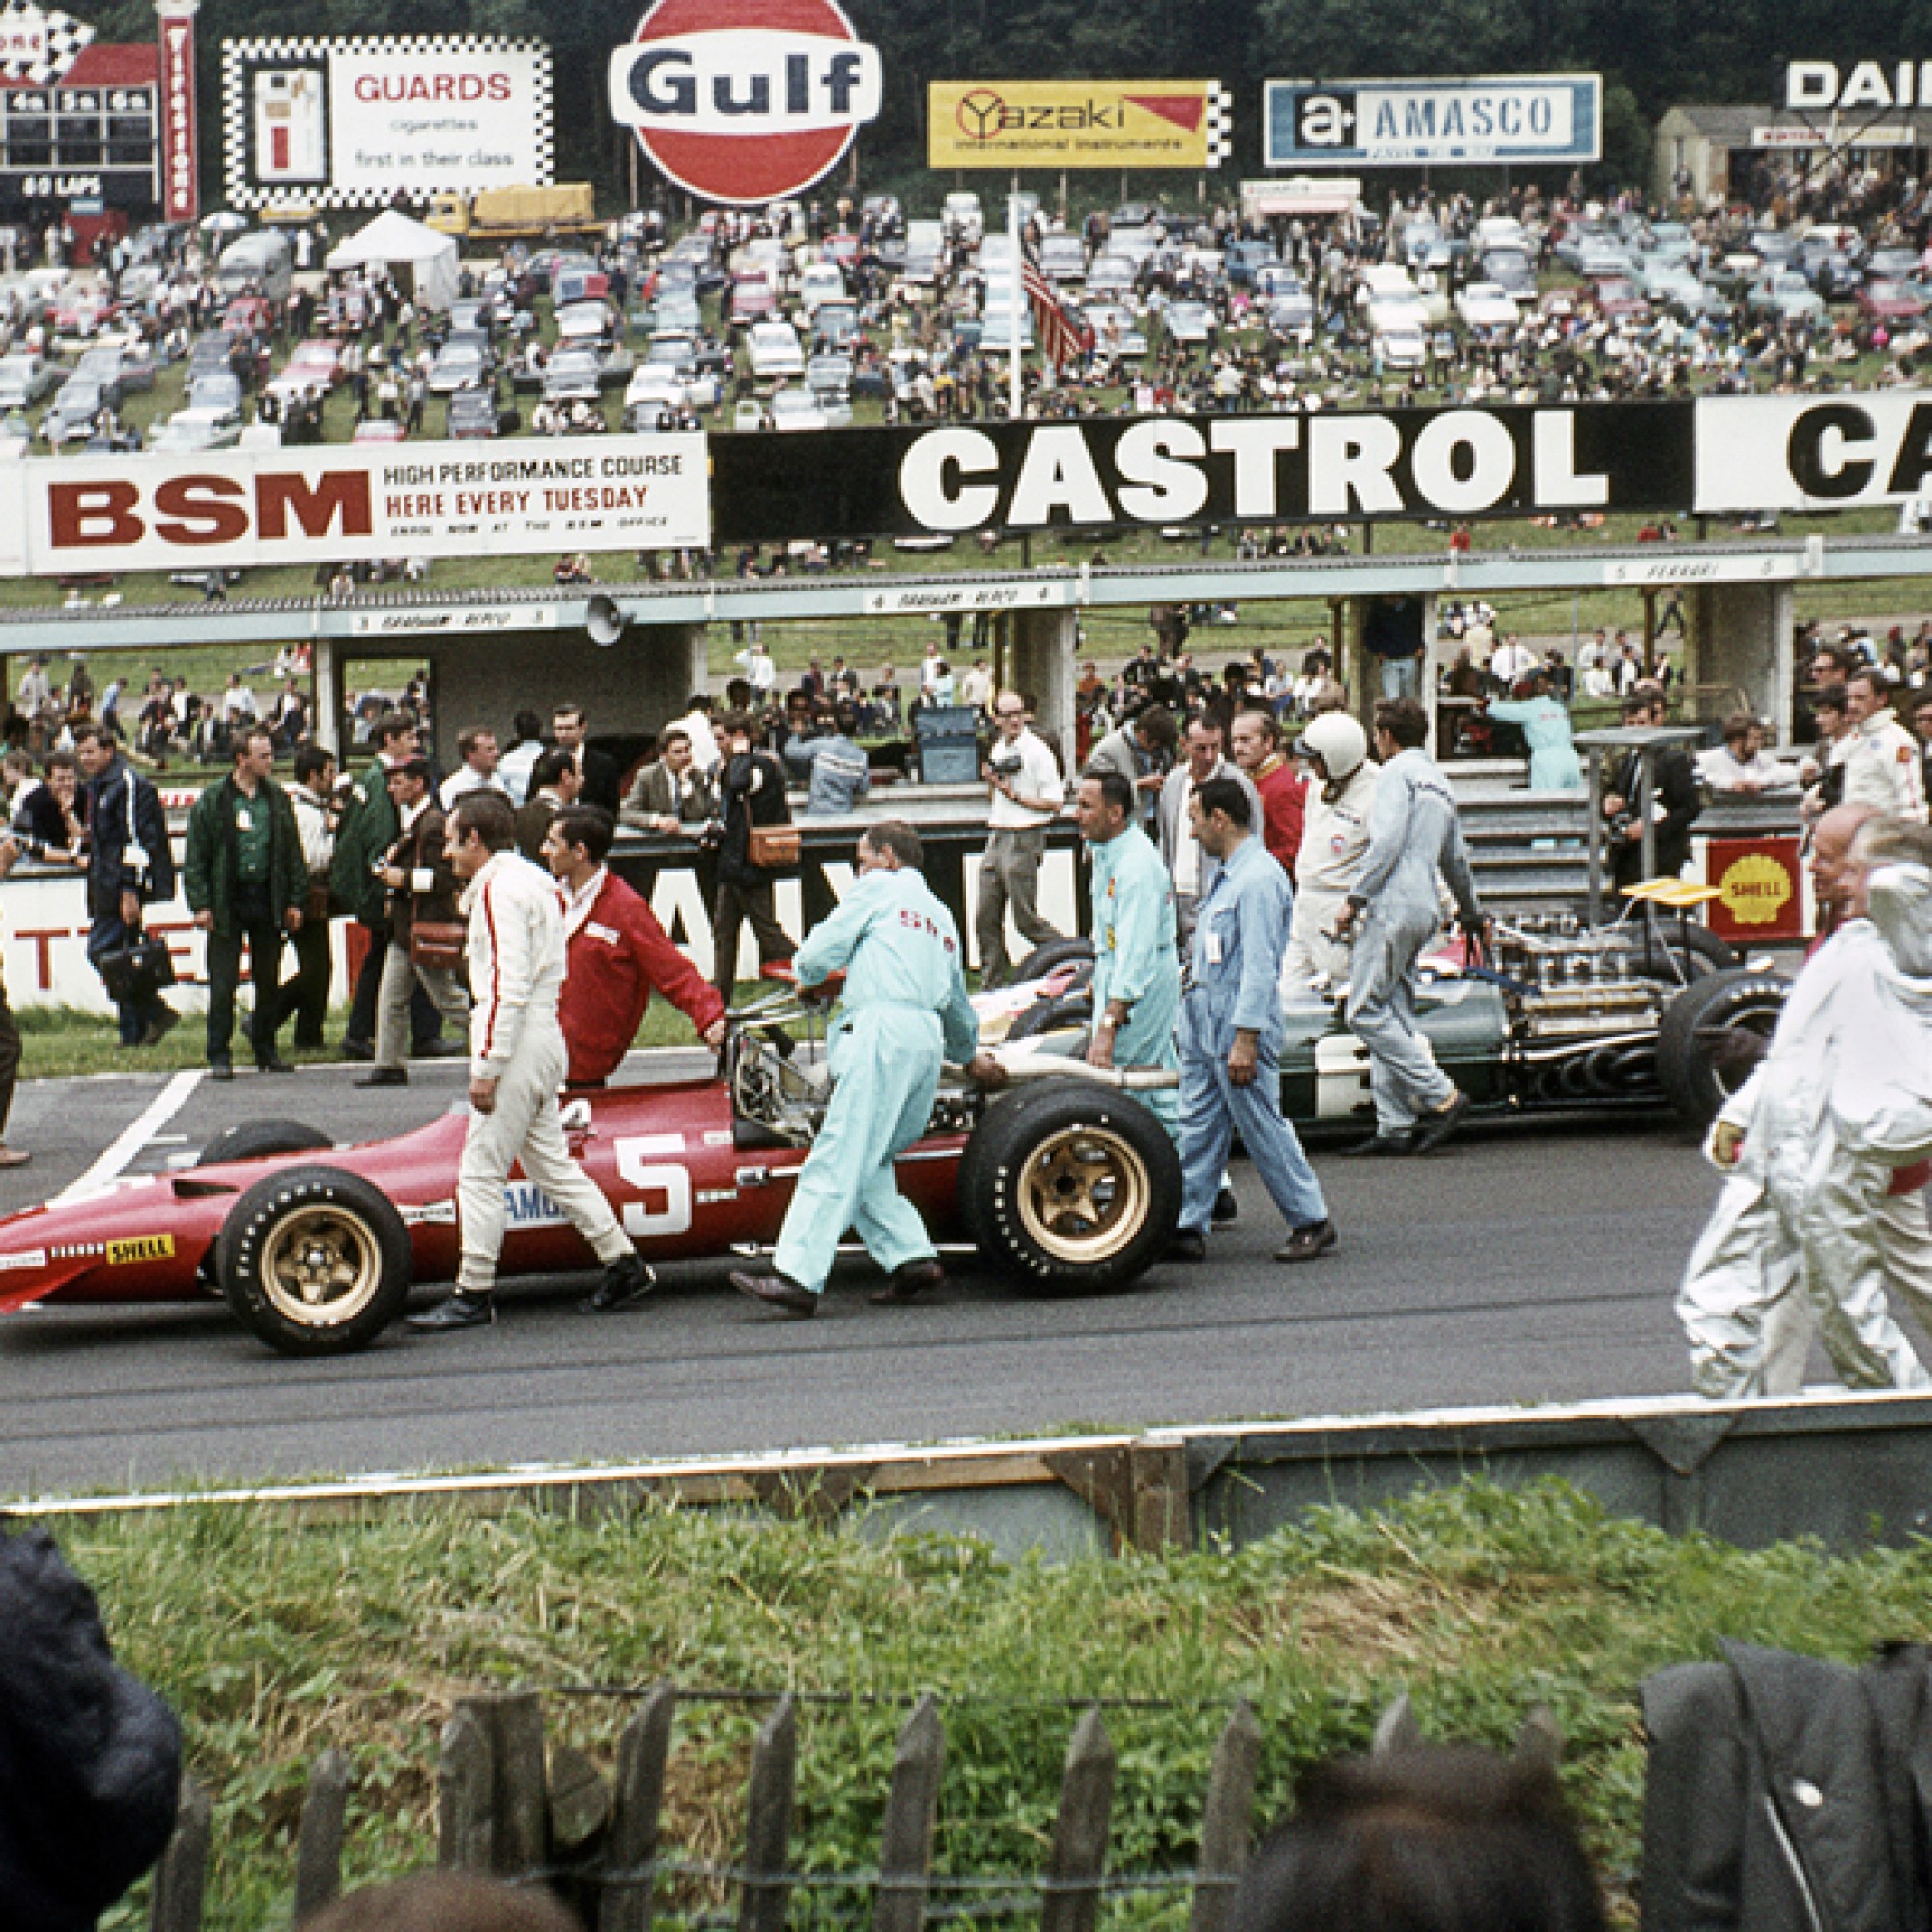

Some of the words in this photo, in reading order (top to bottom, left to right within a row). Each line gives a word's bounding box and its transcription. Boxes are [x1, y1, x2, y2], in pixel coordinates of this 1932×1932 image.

[355, 73, 512, 102] GUARDS
[627, 47, 861, 115] Gulf
[390, 115, 479, 135] cigarettes
[960, 95, 1125, 139] Yazaki
[1374, 96, 1552, 140] AMASCO
[400, 154, 416, 167] in
[421, 148, 463, 167] their
[467, 147, 515, 166] class
[384, 465, 434, 485] HIGH
[439, 457, 595, 484] PERFORMANCE
[600, 455, 683, 477] COURSE
[900, 408, 1609, 530] CASTROL
[48, 469, 374, 549] BSM
[387, 494, 445, 517] HERE
[455, 491, 531, 515] EVERY
[542, 485, 649, 512] TUESDAY
[1731, 881, 1781, 898] SHELL
[613, 1134, 692, 1235] 5
[110, 1236, 169, 1263] SHELL
